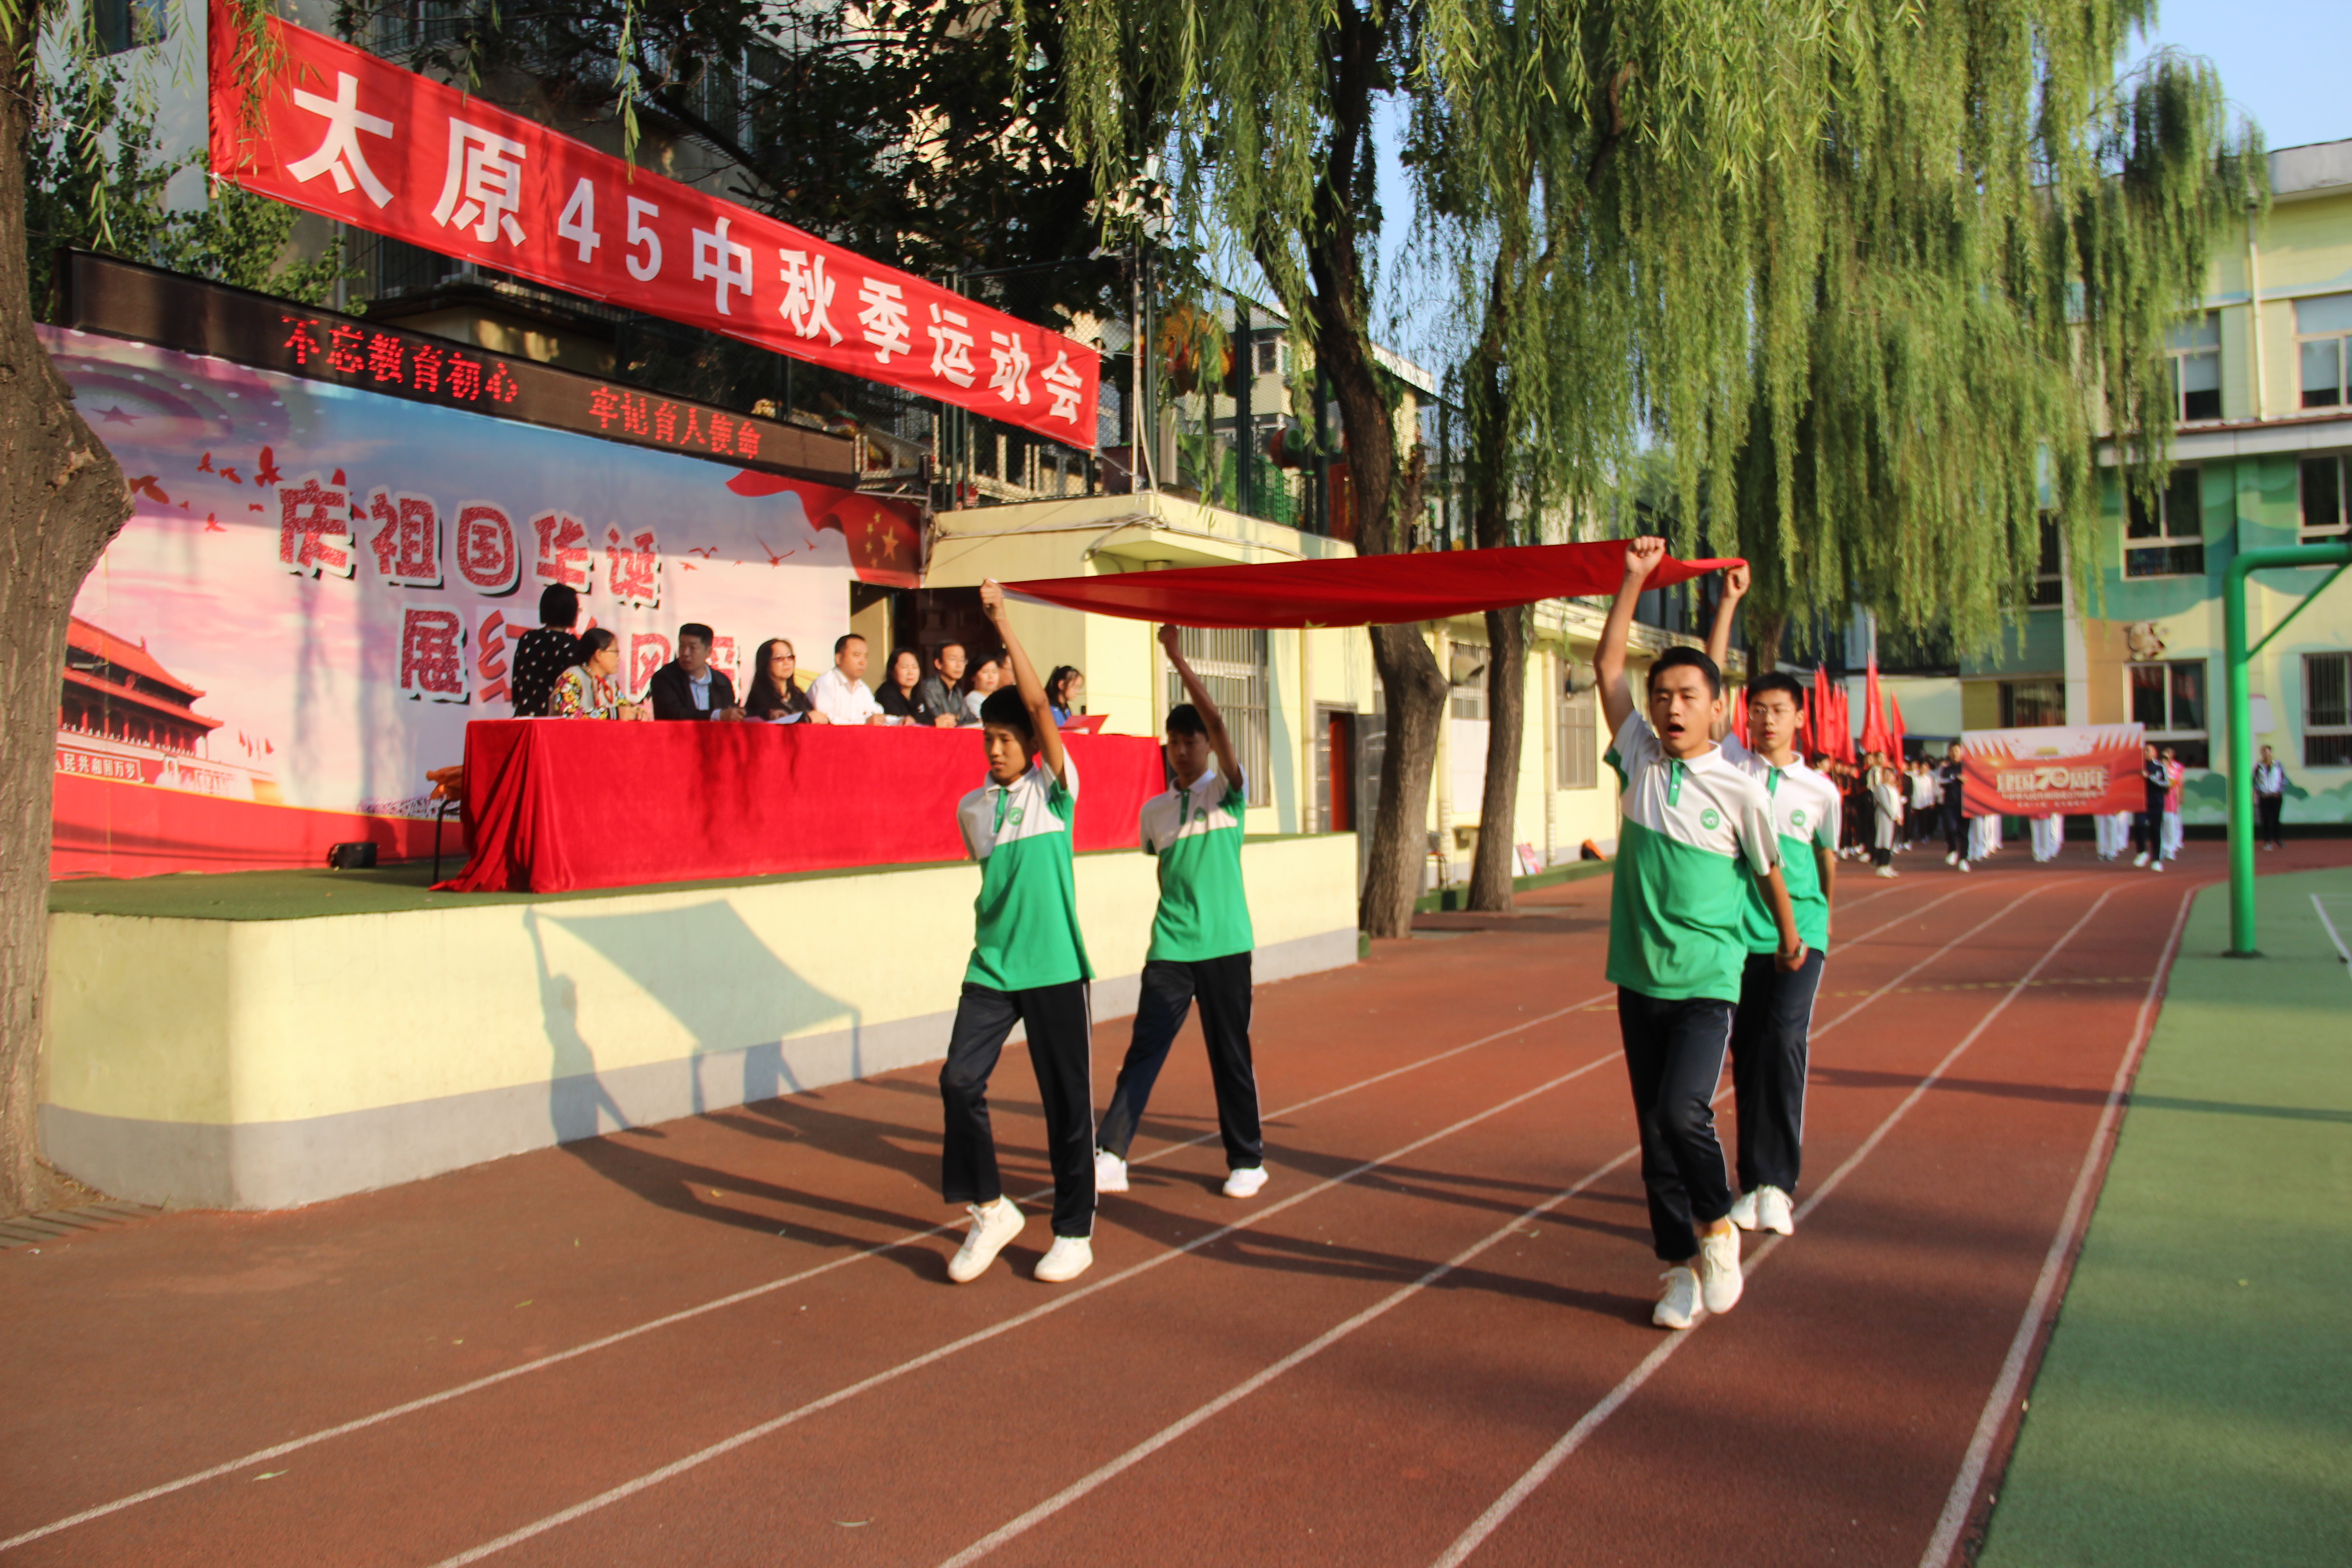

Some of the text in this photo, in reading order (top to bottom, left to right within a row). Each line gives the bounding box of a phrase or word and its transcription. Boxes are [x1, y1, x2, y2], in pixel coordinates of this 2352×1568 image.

[285, 71, 1083, 426] 太原45中秋季运动会
[282, 316, 761, 460] 不忘教育初心 牢记育人使命
[279, 478, 656, 601] 庆祖国华诞
